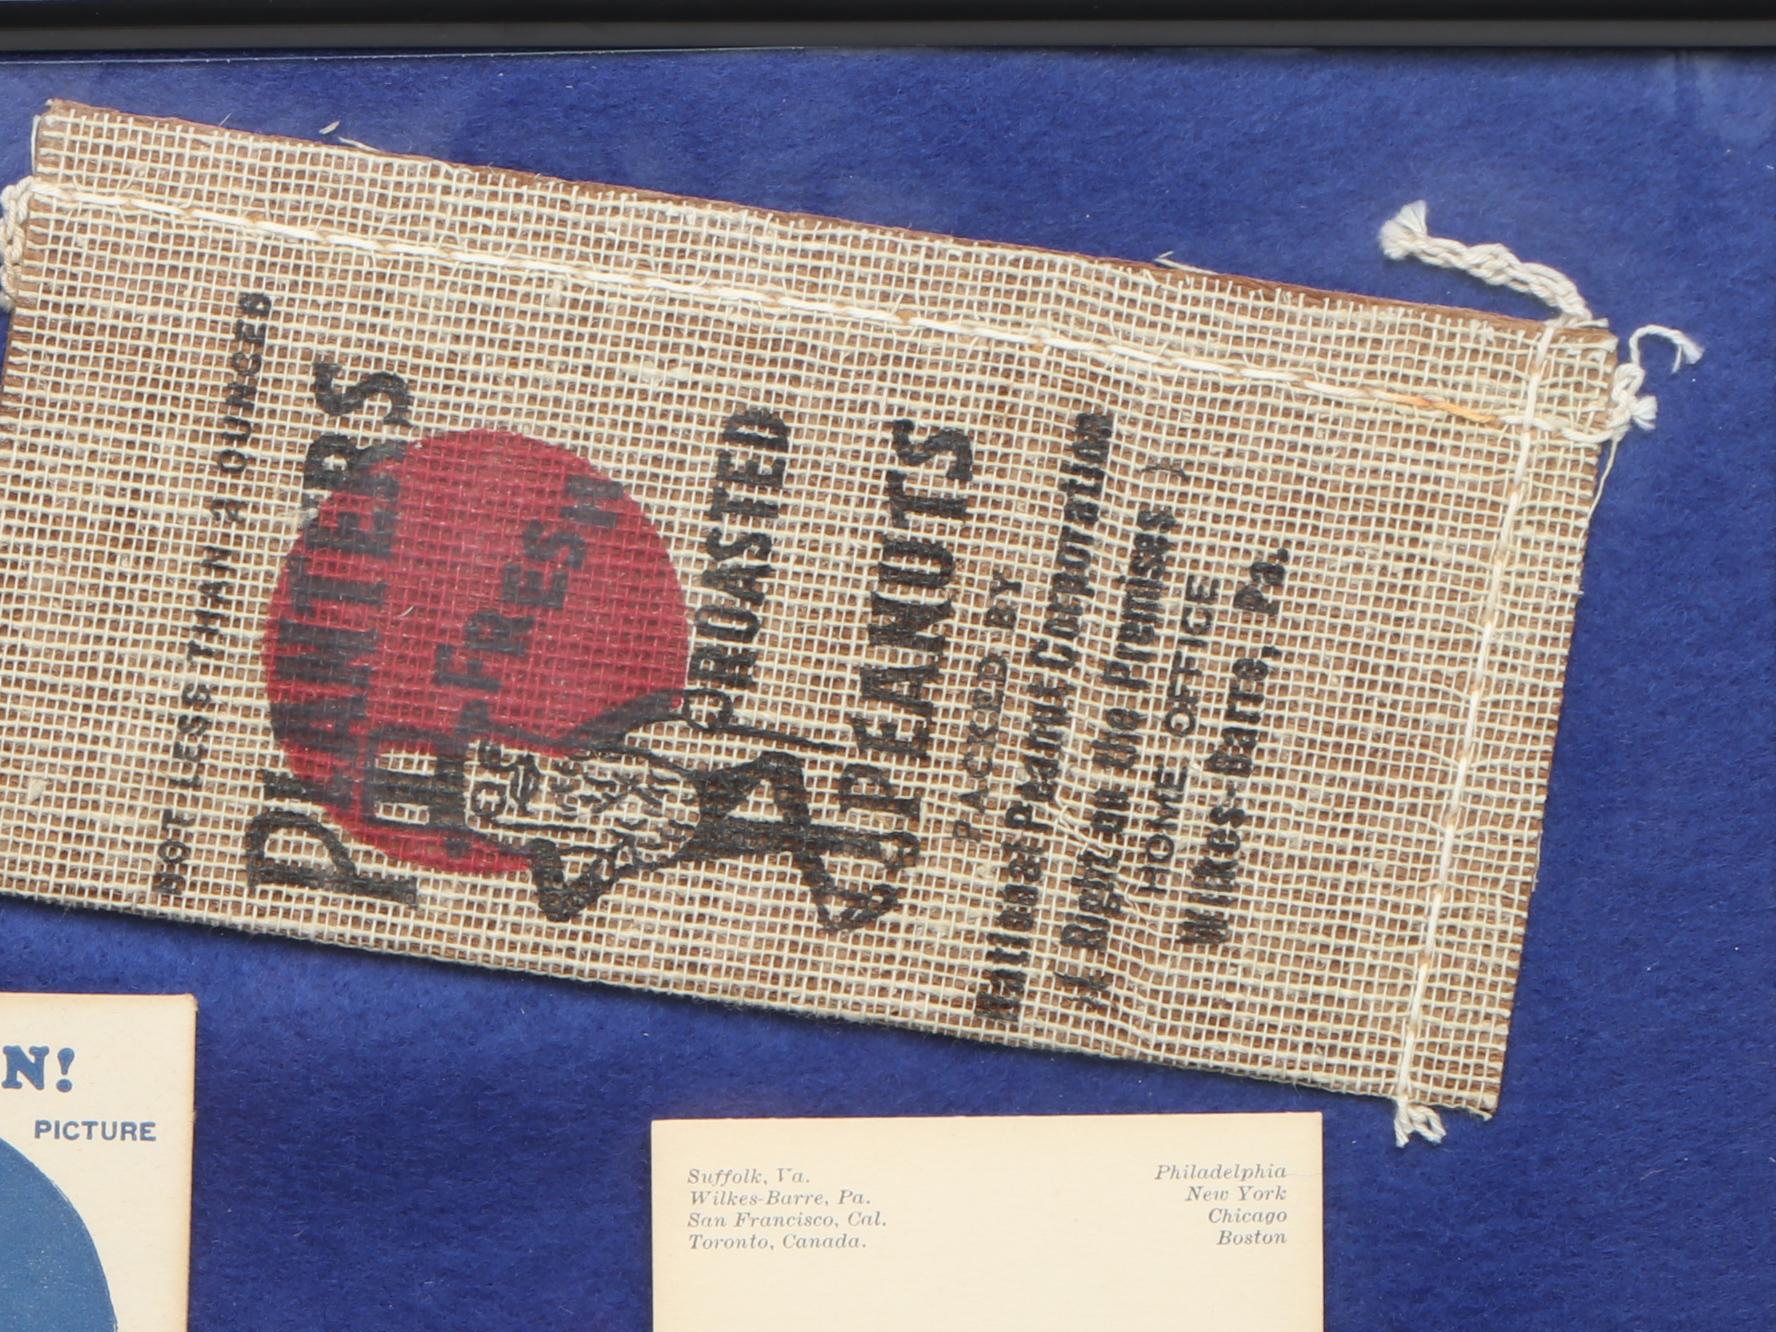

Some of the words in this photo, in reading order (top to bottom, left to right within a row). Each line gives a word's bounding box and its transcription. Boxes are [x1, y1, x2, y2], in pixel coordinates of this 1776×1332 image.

[688, 406, 791, 690] ROASTED
[435, 473, 627, 692] FRESH
[983, 571, 1023, 628] BY
[838, 416, 974, 822] PEANUTS
[246, 361, 418, 908] PLANTERS
[1159, 573, 1220, 739] OFFICE
[1133, 761, 1189, 897] HOME
[33, 1119, 158, 1143] PICTURE
[1154, 1163, 1287, 1182] Philadelphia
[690, 1189, 829, 1206] Wilkes-Barre,
[838, 1189, 871, 1205] Pa.
[1184, 1185, 1229, 1202] New
[1237, 1184, 1287, 1202] York
[687, 1212, 726, 1228] San
[734, 1211, 839, 1228] Francisco,
[847, 1210, 887, 1227] Cal.
[1208, 1207, 1288, 1225] Chicago
[688, 1233, 774, 1250] Toronto,
[782, 1232, 867, 1249] Canada.
[1216, 1229, 1288, 1246] Boston
